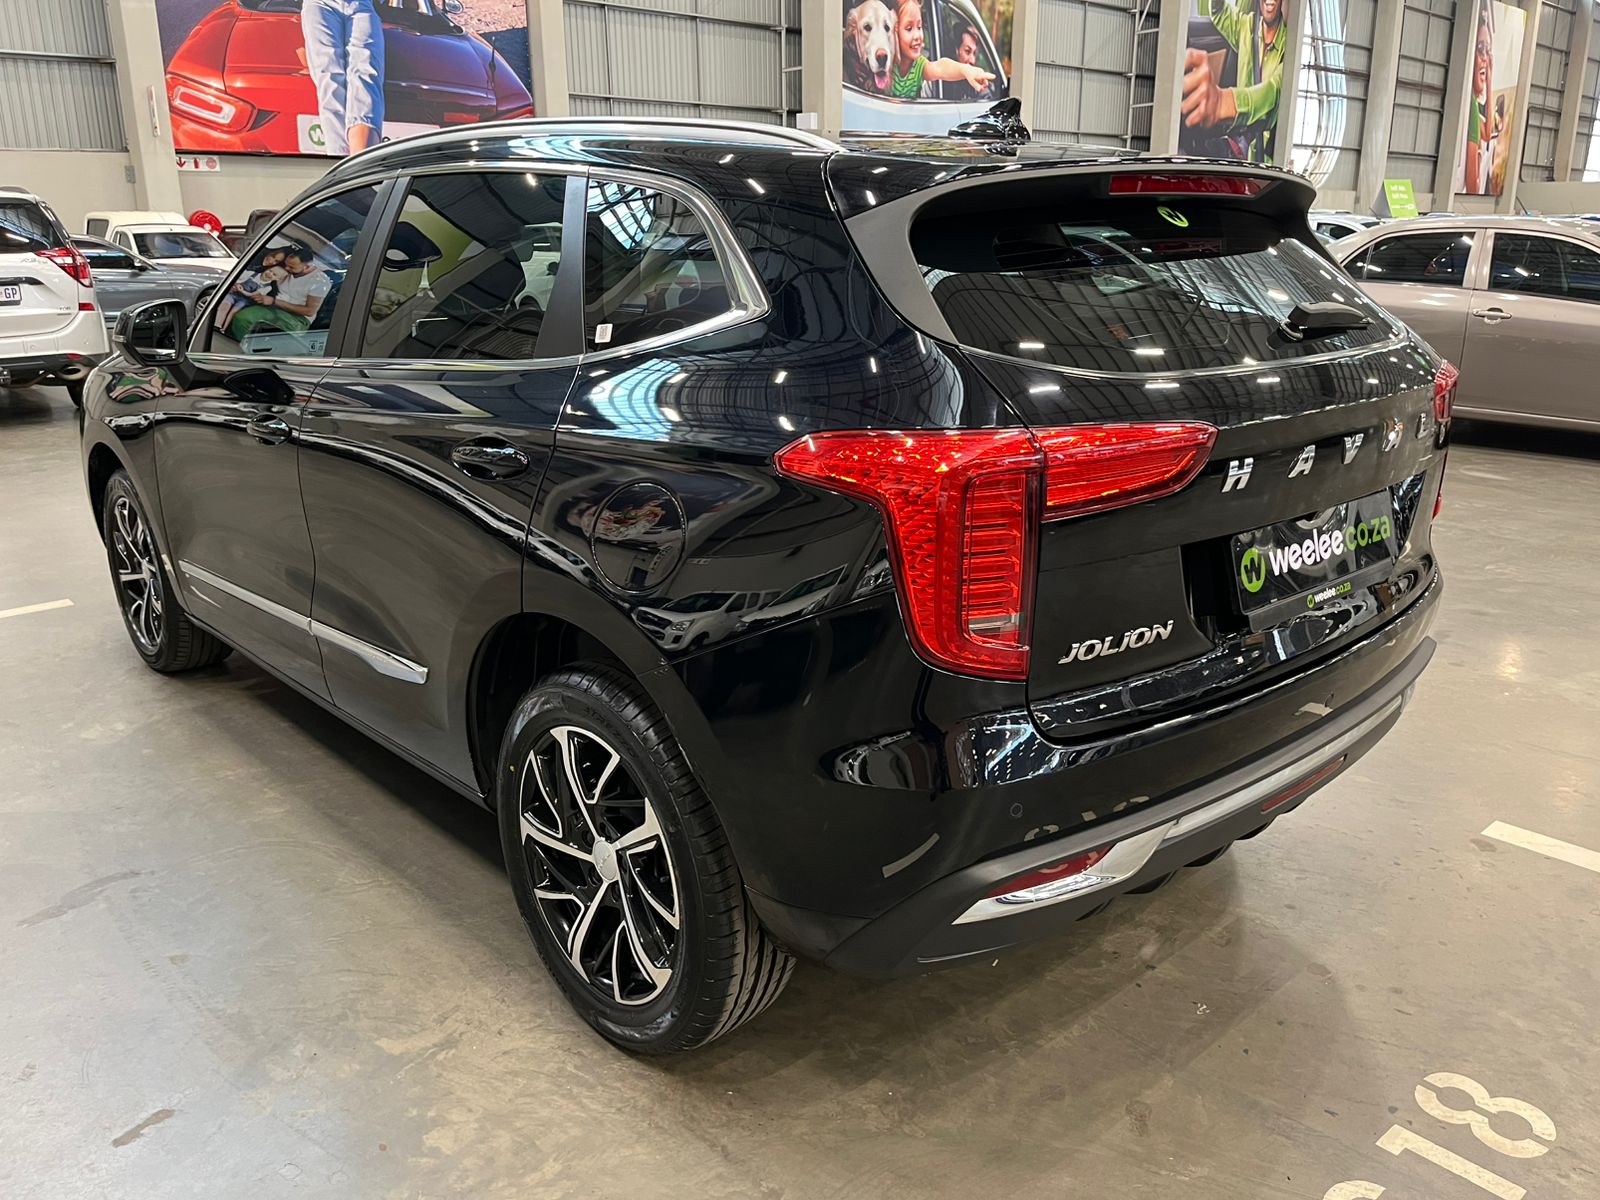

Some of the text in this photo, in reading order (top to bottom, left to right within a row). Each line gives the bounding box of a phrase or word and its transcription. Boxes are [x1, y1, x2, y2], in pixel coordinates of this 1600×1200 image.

[4, 287, 18, 299] GP
[1221, 412, 1428, 493] HAVAL
[1268, 515, 1392, 577] weelee.co.za
[1314, 582, 1351, 603] weelee.co.za
[1058, 619, 1175, 664] JOLION
